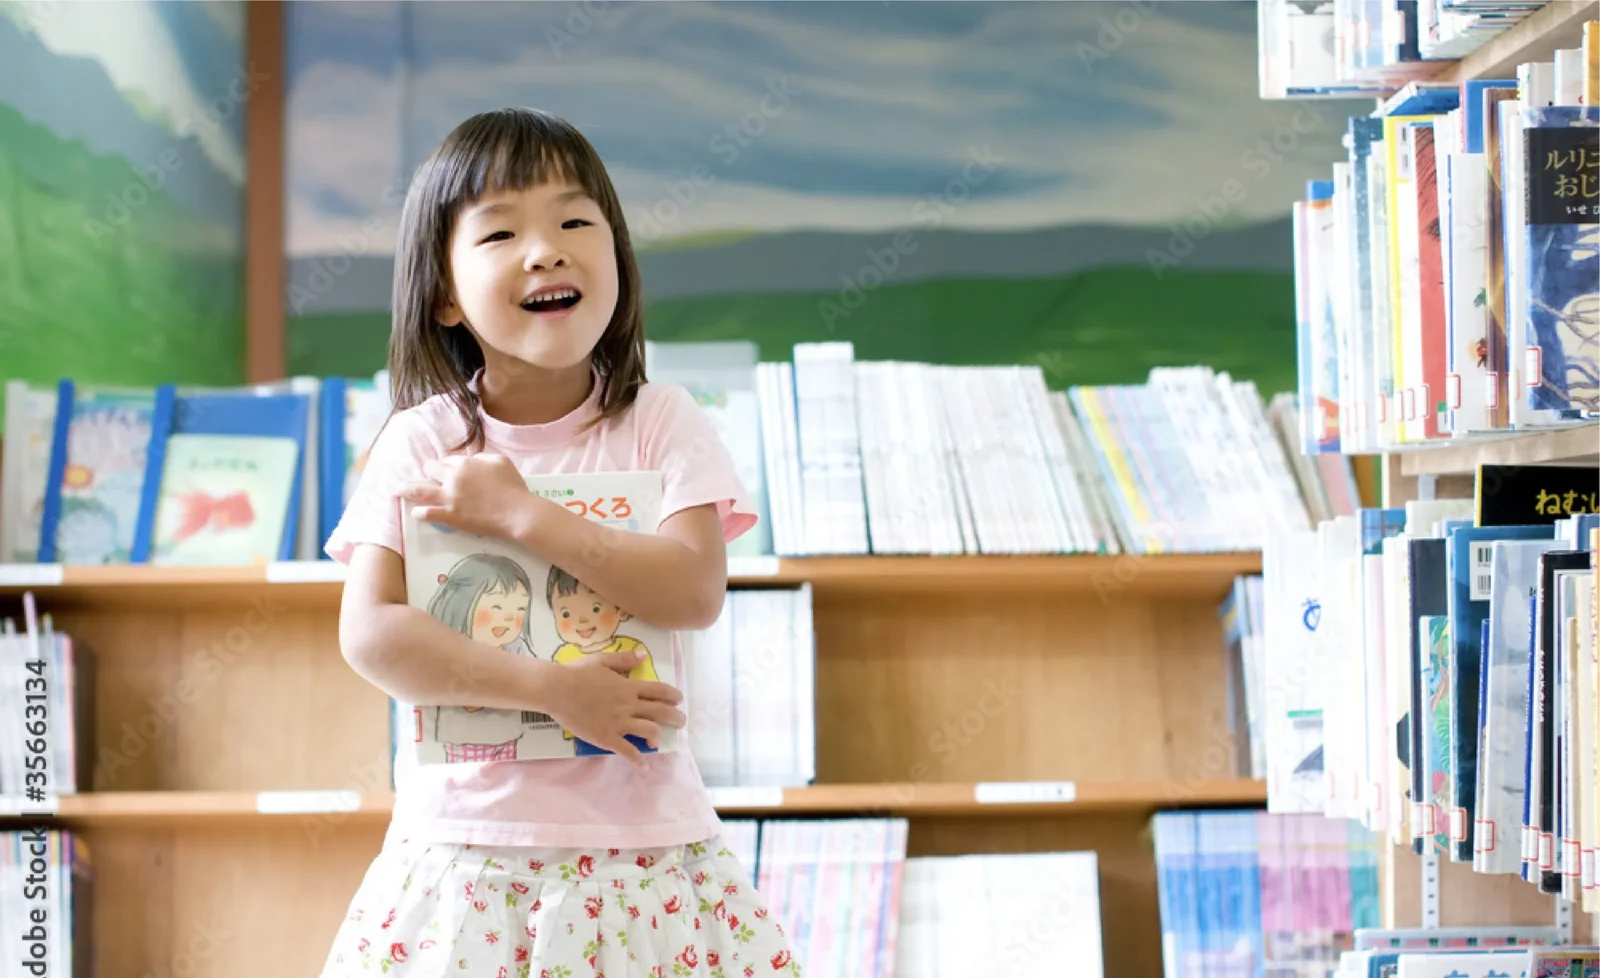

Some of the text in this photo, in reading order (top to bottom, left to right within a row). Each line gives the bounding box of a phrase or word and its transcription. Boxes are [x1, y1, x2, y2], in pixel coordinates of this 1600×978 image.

[1553, 173, 1598, 198] おじ
[564, 496, 632, 519] つくろ
